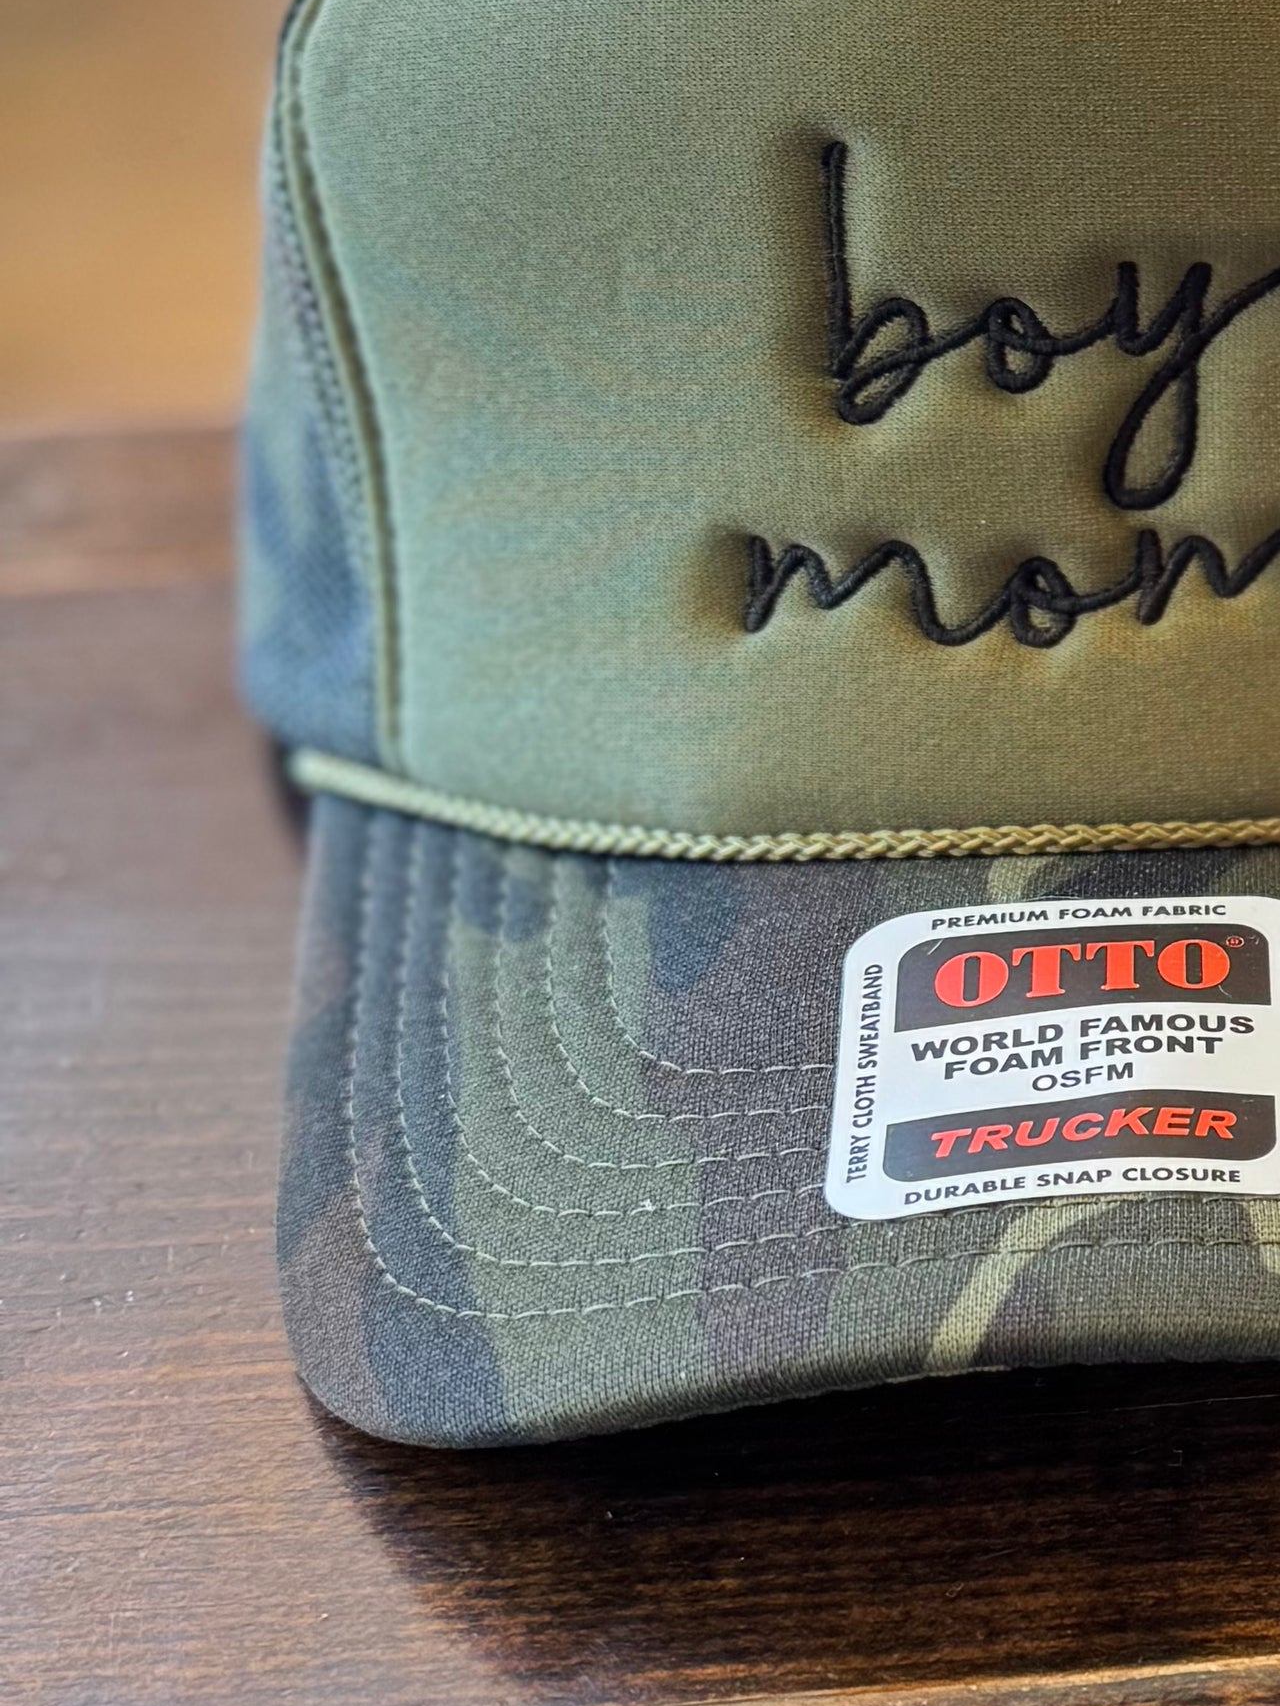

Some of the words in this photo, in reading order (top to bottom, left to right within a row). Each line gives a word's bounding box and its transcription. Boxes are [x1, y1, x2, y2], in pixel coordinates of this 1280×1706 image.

[931, 909, 1049, 931] PREMIUM
[1059, 906, 1133, 919] FOAM
[1142, 904, 1227, 917] FABRIC
[858, 964, 884, 1068] SWEATBAND
[911, 1024, 1065, 1062] WORLD
[1078, 1014, 1254, 1037] FAMOUS
[944, 1046, 1063, 1080] FOAM
[1079, 1036, 1224, 1060] FRONT
[1031, 1063, 1134, 1091] OSFM
[853, 1071, 876, 1131] CLOTH
[930, 1107, 1238, 1158] TRUCKER
[846, 1134, 869, 1184] TERRY
[904, 1175, 1026, 1205] DURABLE
[1036, 1168, 1113, 1187] SNAP
[1122, 1167, 1241, 1184] CLOSURE
